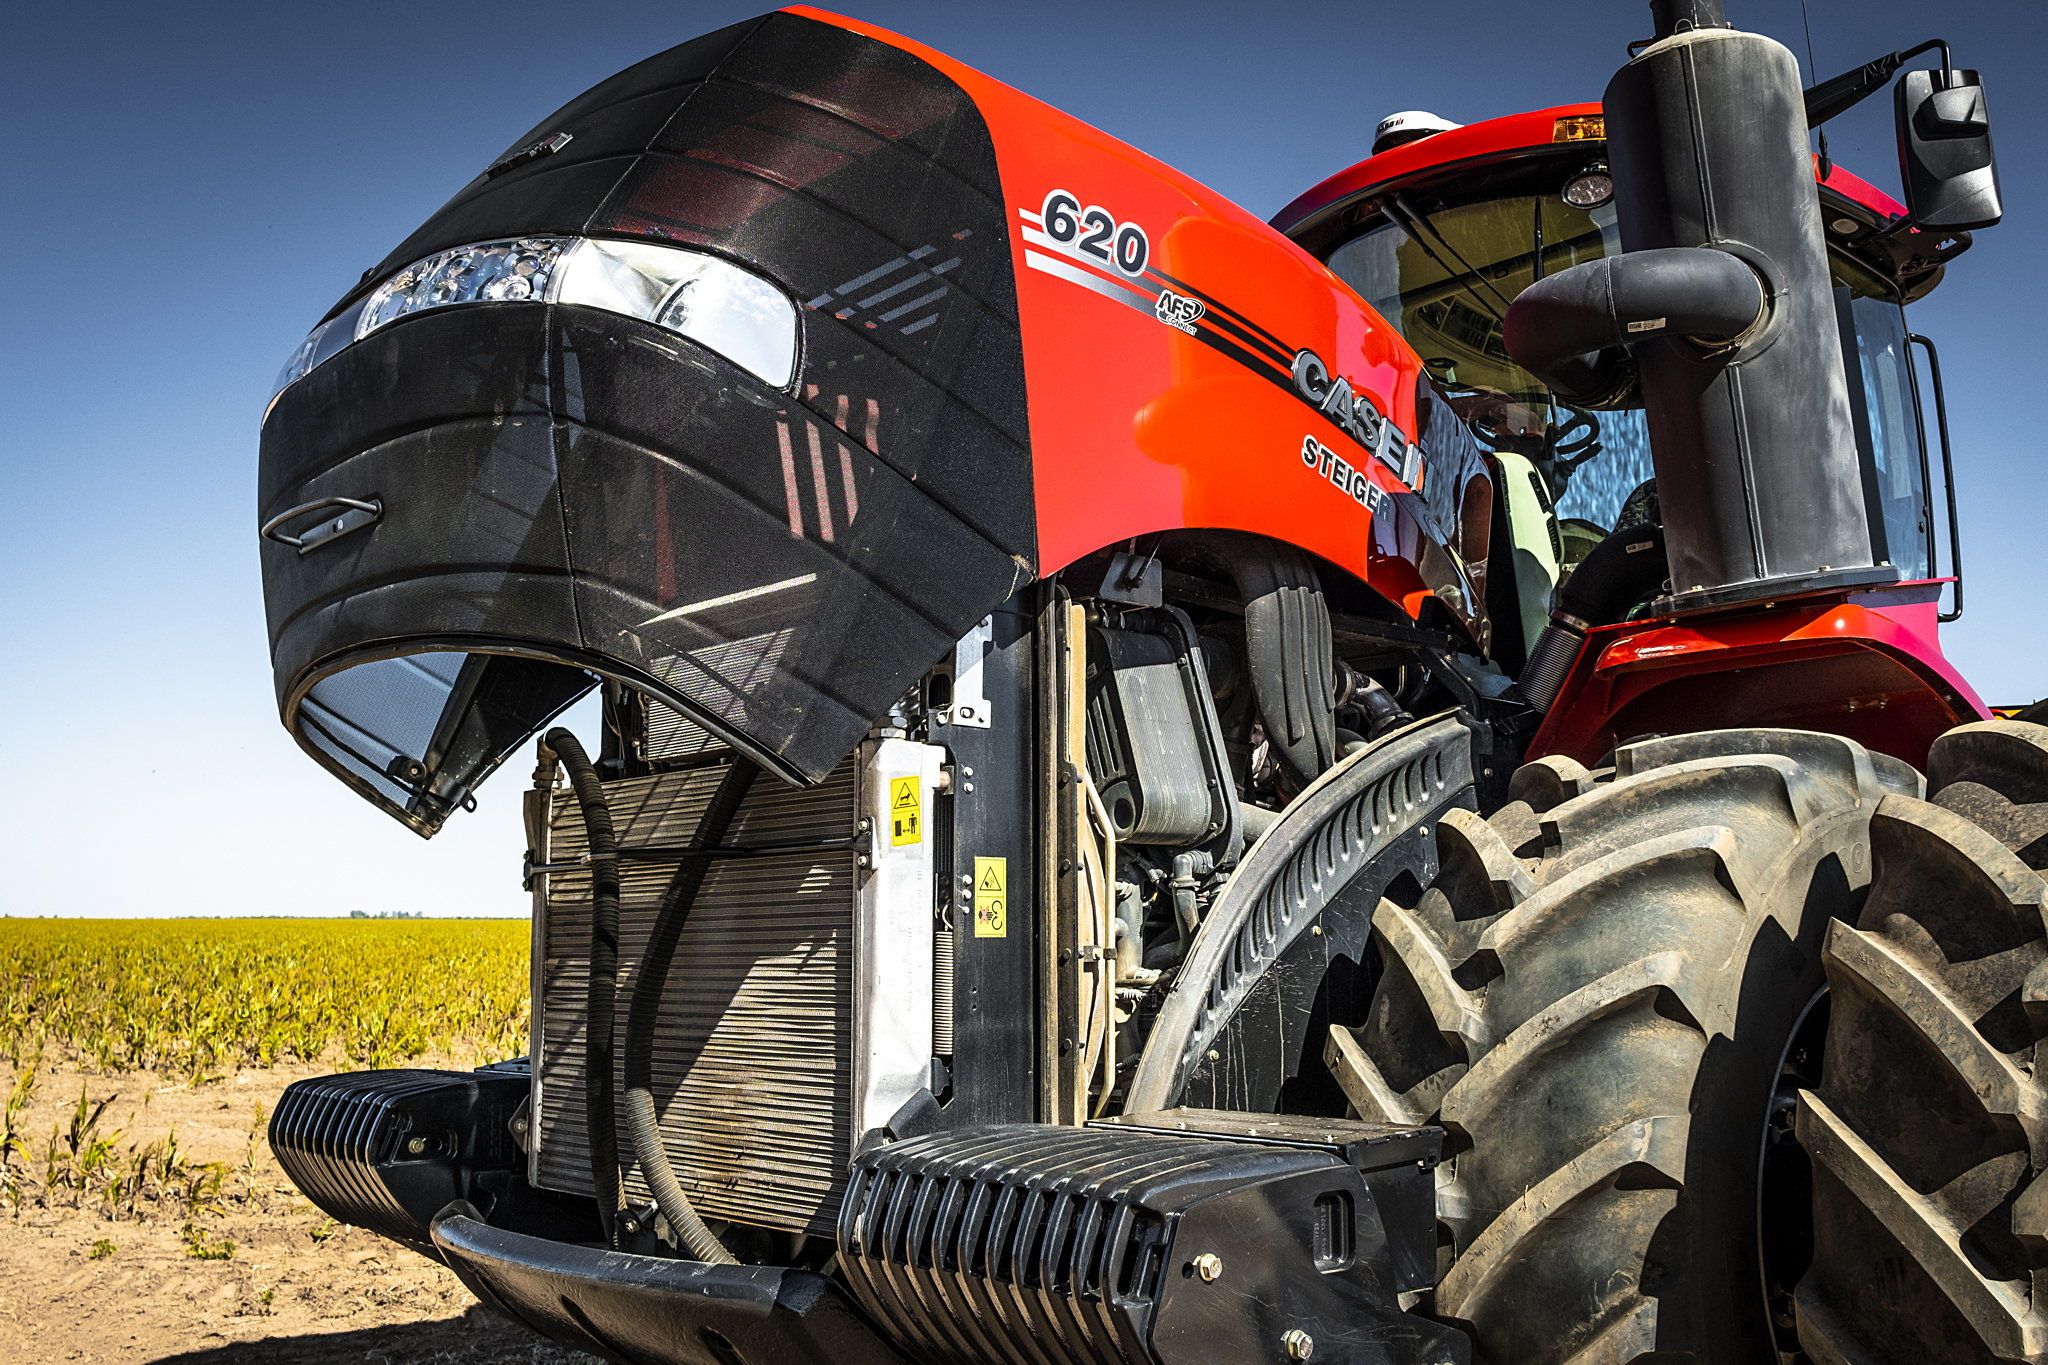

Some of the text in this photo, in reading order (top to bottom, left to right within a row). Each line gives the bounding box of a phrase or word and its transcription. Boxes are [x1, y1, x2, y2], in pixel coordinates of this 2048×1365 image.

[1042, 190, 1149, 277] 620
[1157, 291, 1196, 321] AFS
[1166, 315, 1197, 336] CONNECT
[1292, 349, 1405, 474] CASE
[1302, 435, 1391, 524] STEIGER
